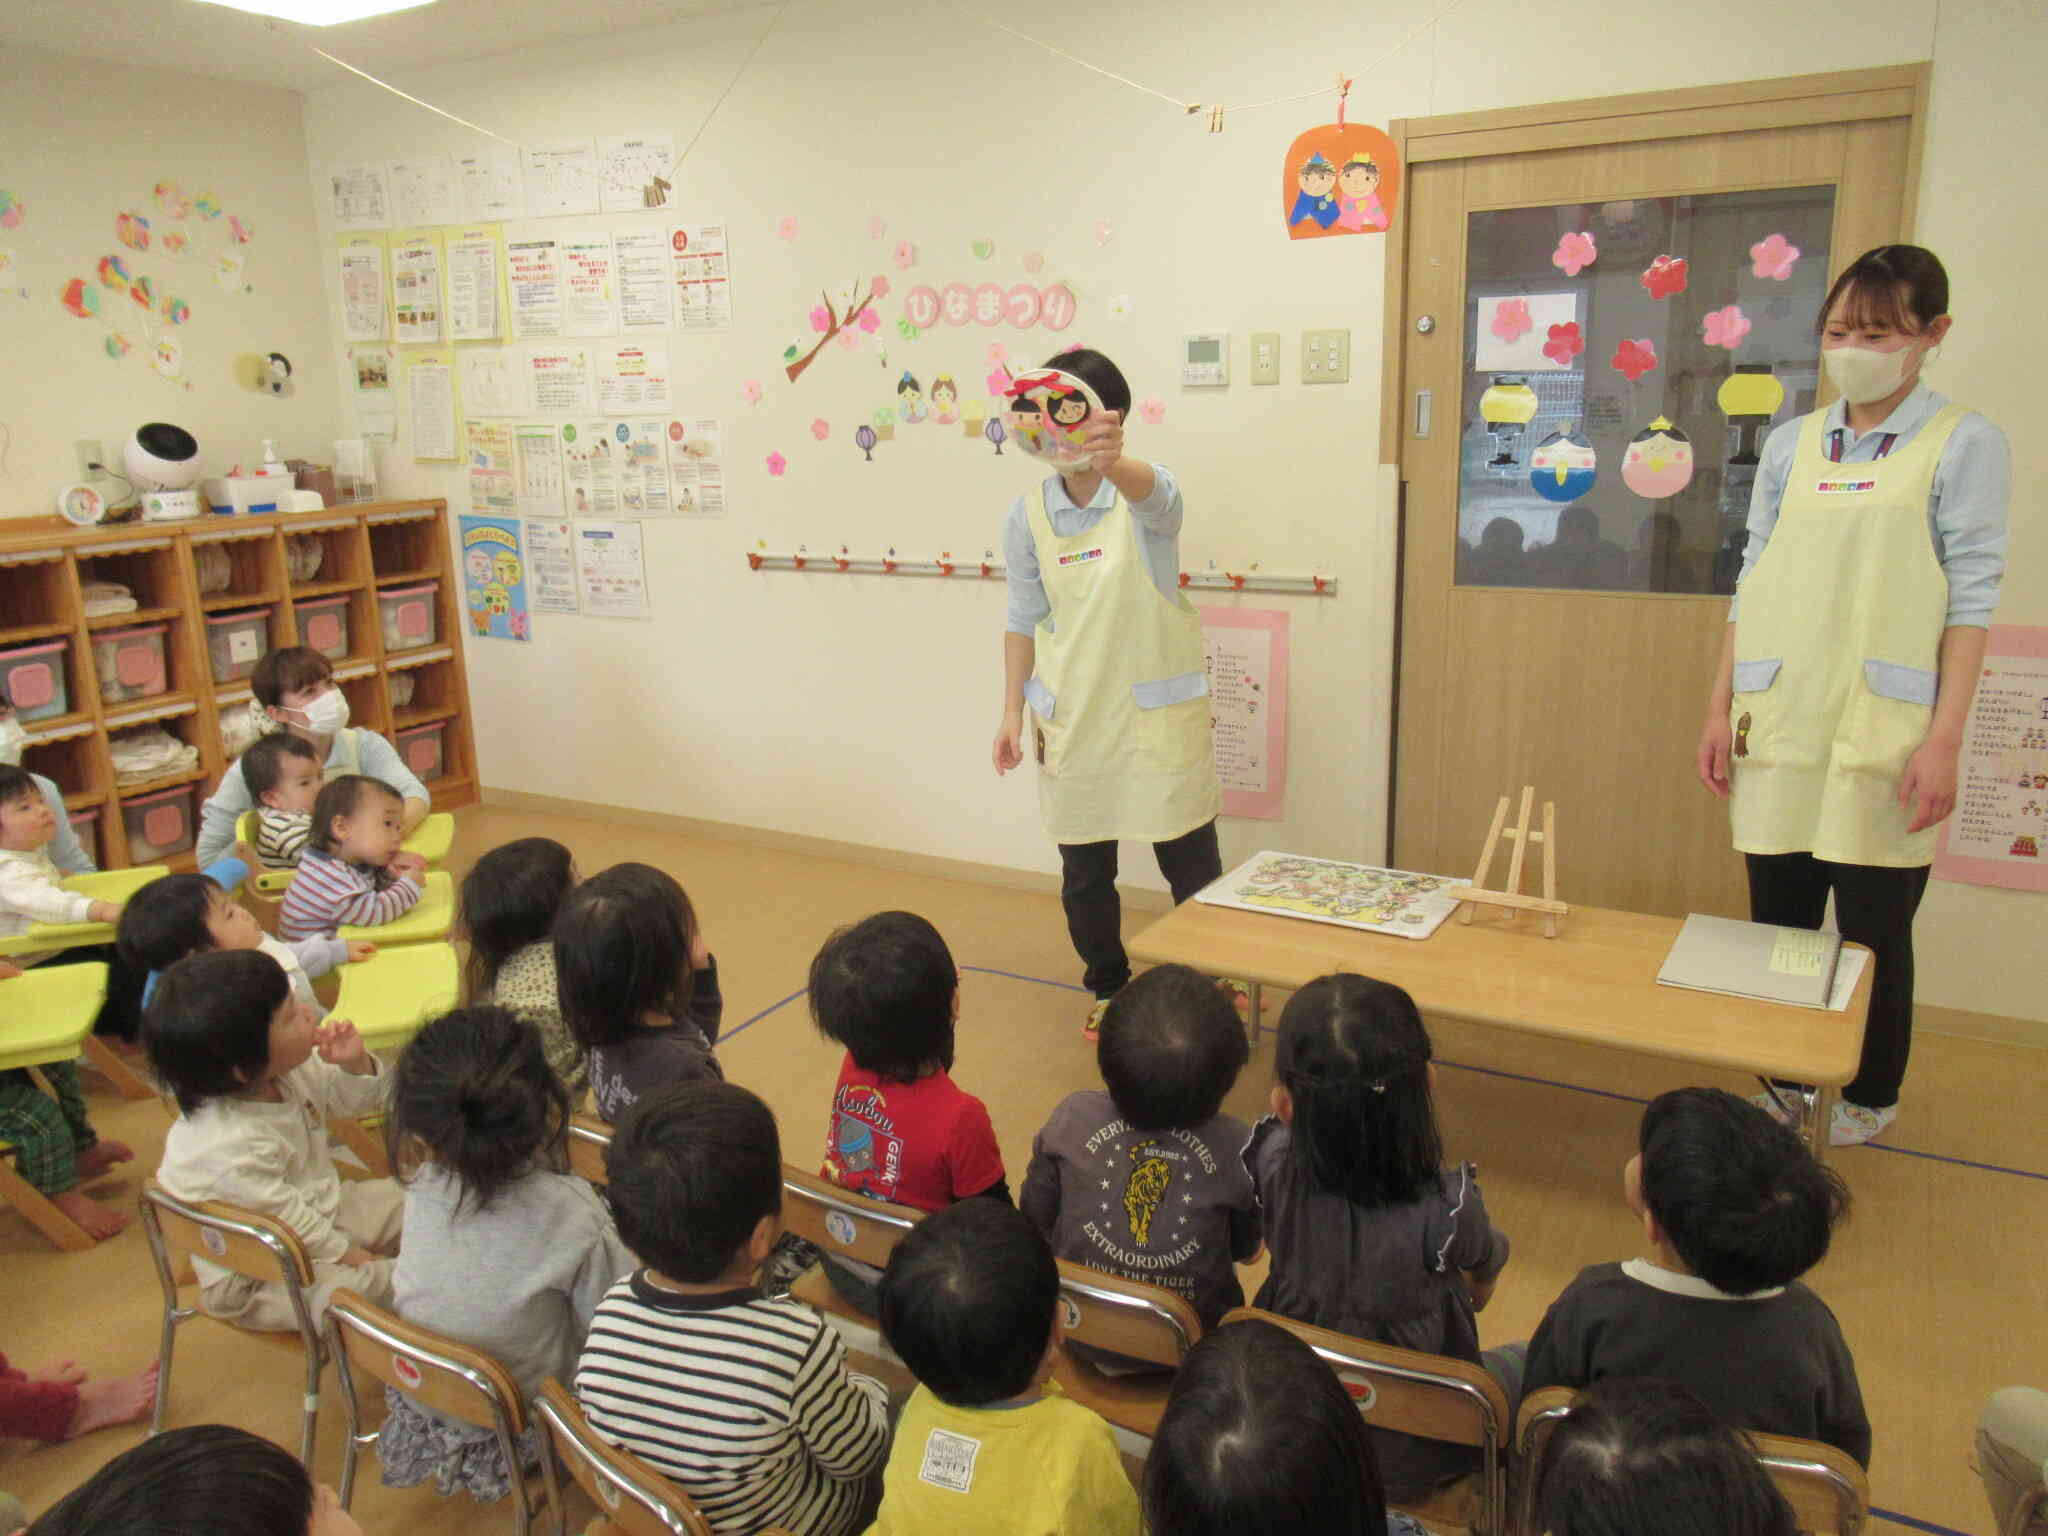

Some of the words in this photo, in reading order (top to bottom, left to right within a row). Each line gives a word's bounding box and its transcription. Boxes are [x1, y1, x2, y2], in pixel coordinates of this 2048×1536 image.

[909, 286, 1071, 329] ひなまつり
[1168, 1127, 1217, 1174] LOTHES
[1083, 1221, 1200, 1270] EXTRAORDINARY
[1154, 1276, 1195, 1288] TIGER
